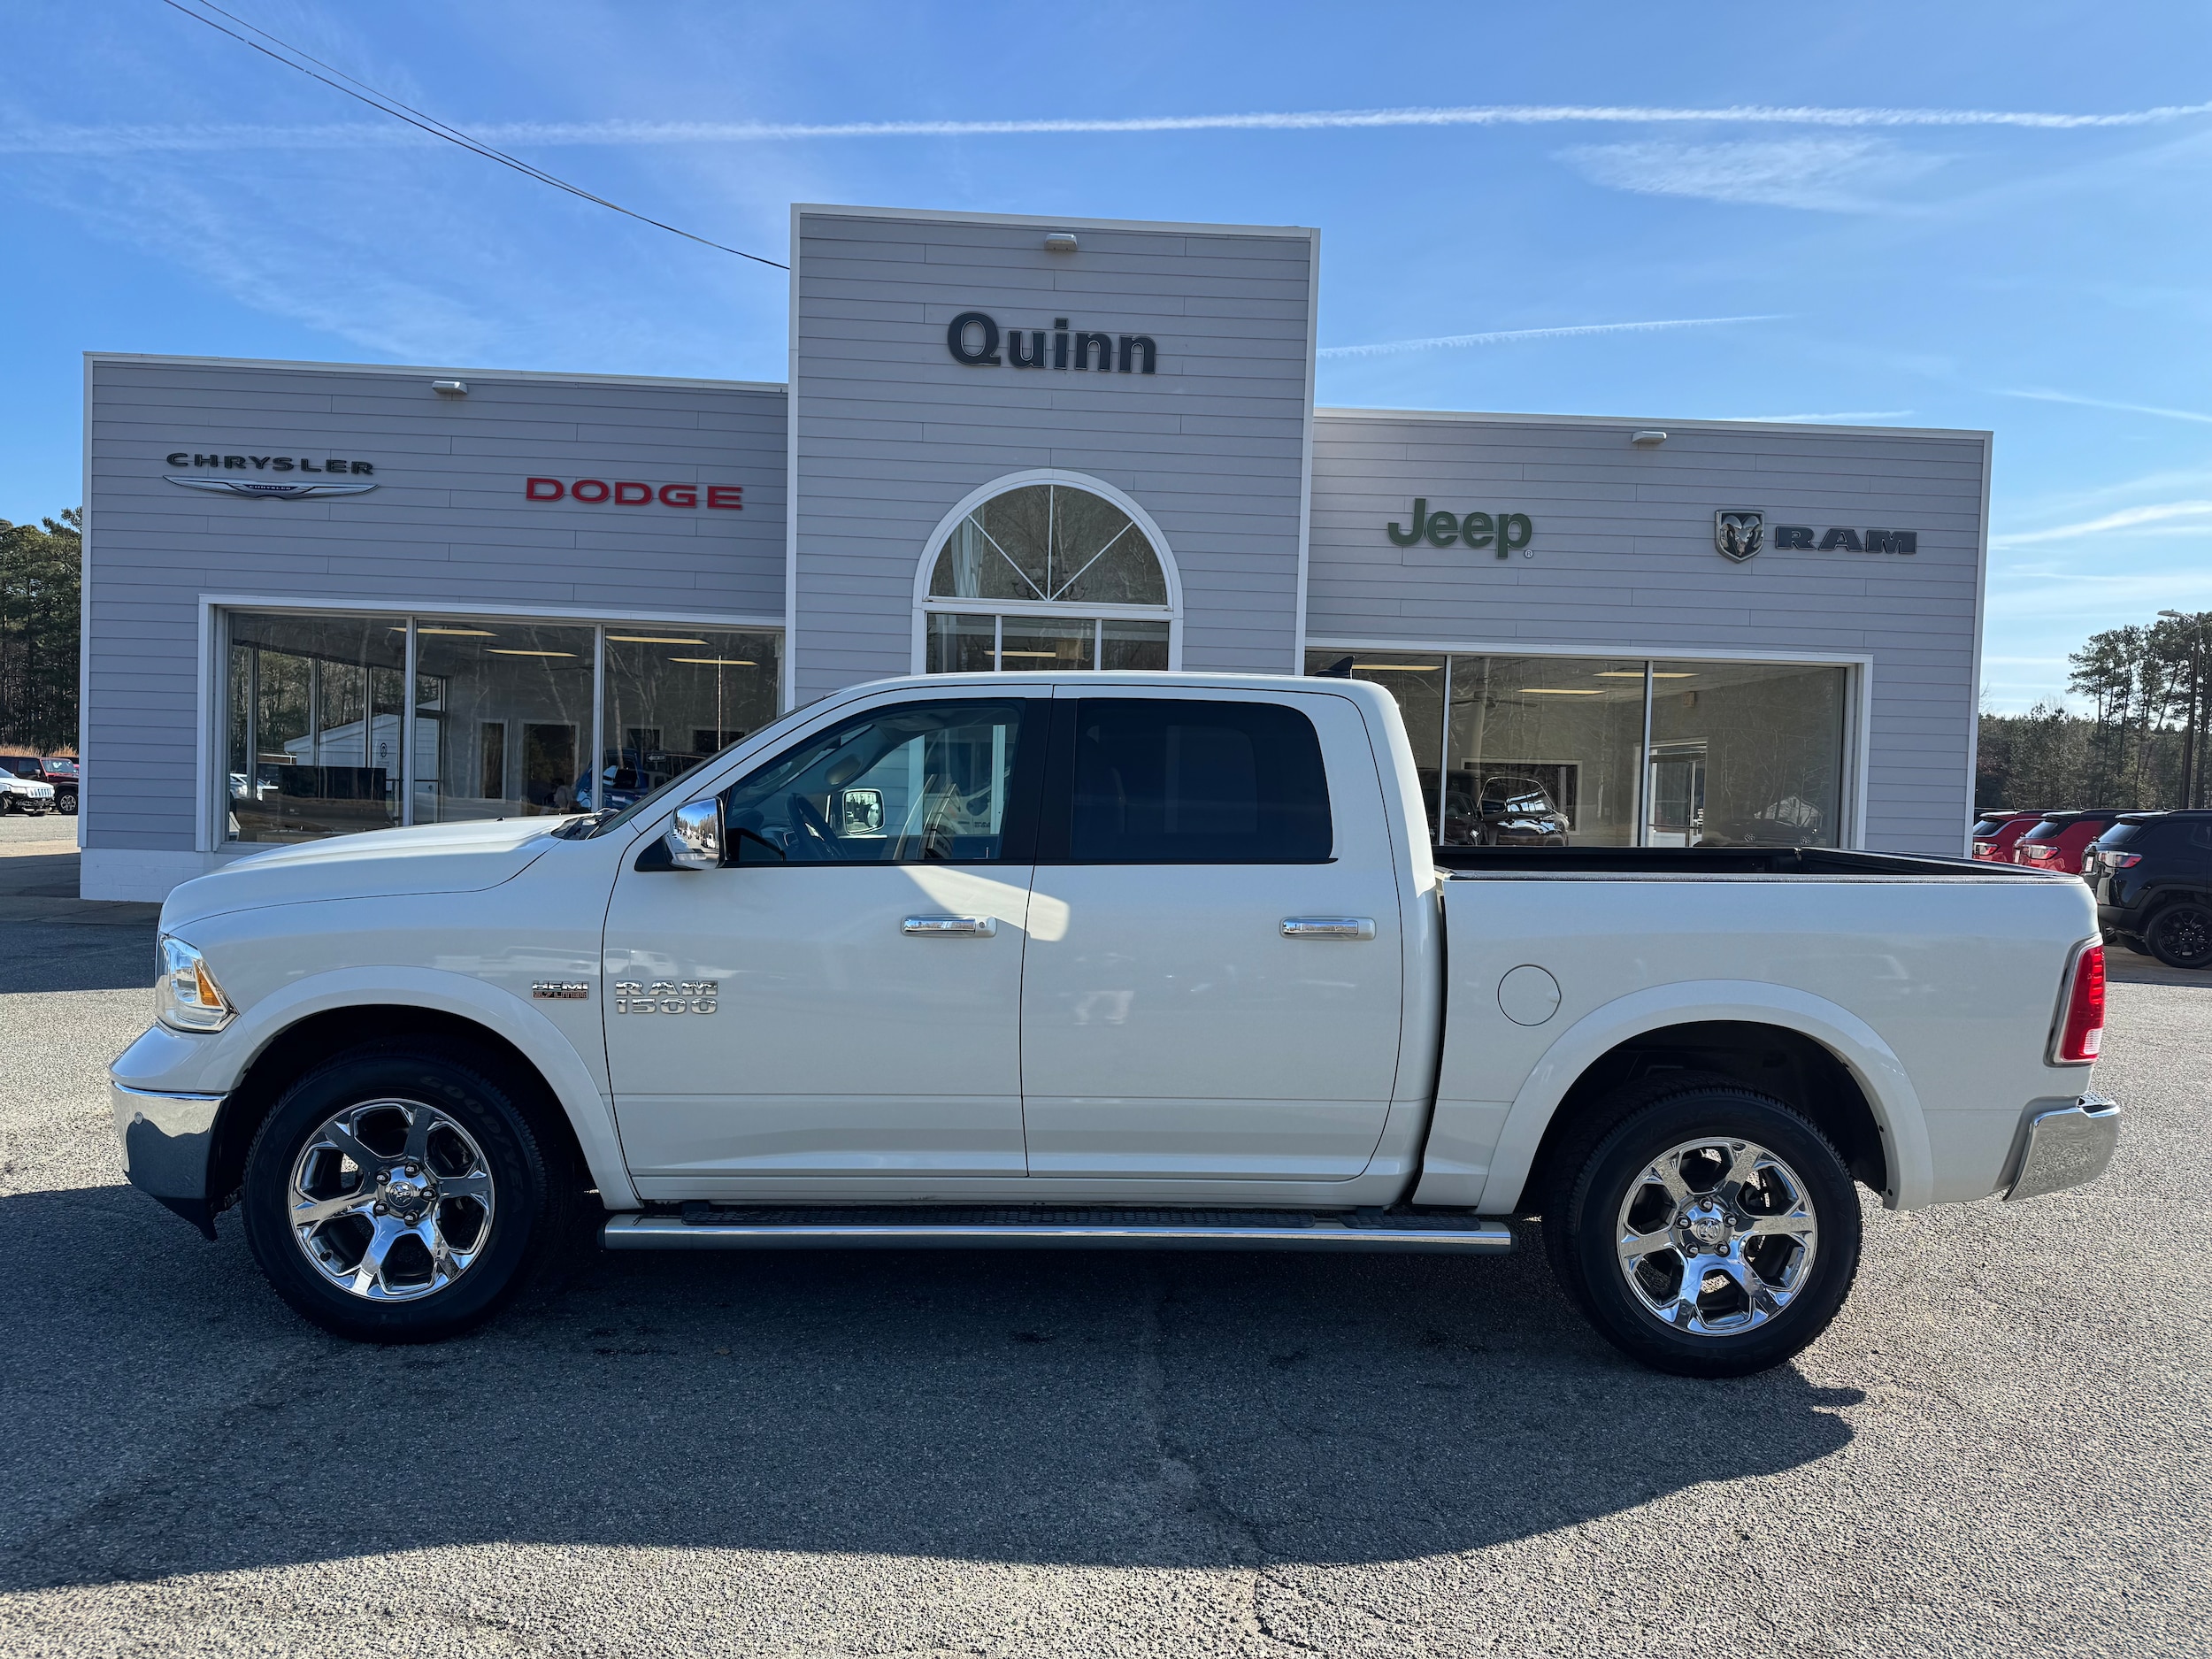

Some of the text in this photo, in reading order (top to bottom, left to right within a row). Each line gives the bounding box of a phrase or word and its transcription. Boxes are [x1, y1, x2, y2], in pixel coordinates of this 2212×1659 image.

[947, 311, 1156, 374] Quinn
[166, 452, 373, 475] CHRYSLER
[526, 477, 743, 511] DODGE
[1387, 497, 1532, 559] Jeep
[1775, 526, 1918, 555] RAM
[532, 980, 588, 991] HEMI
[616, 979, 718, 996] RAM
[616, 997, 718, 1015] 1500
[419, 1075, 525, 1219] GOODYEA
